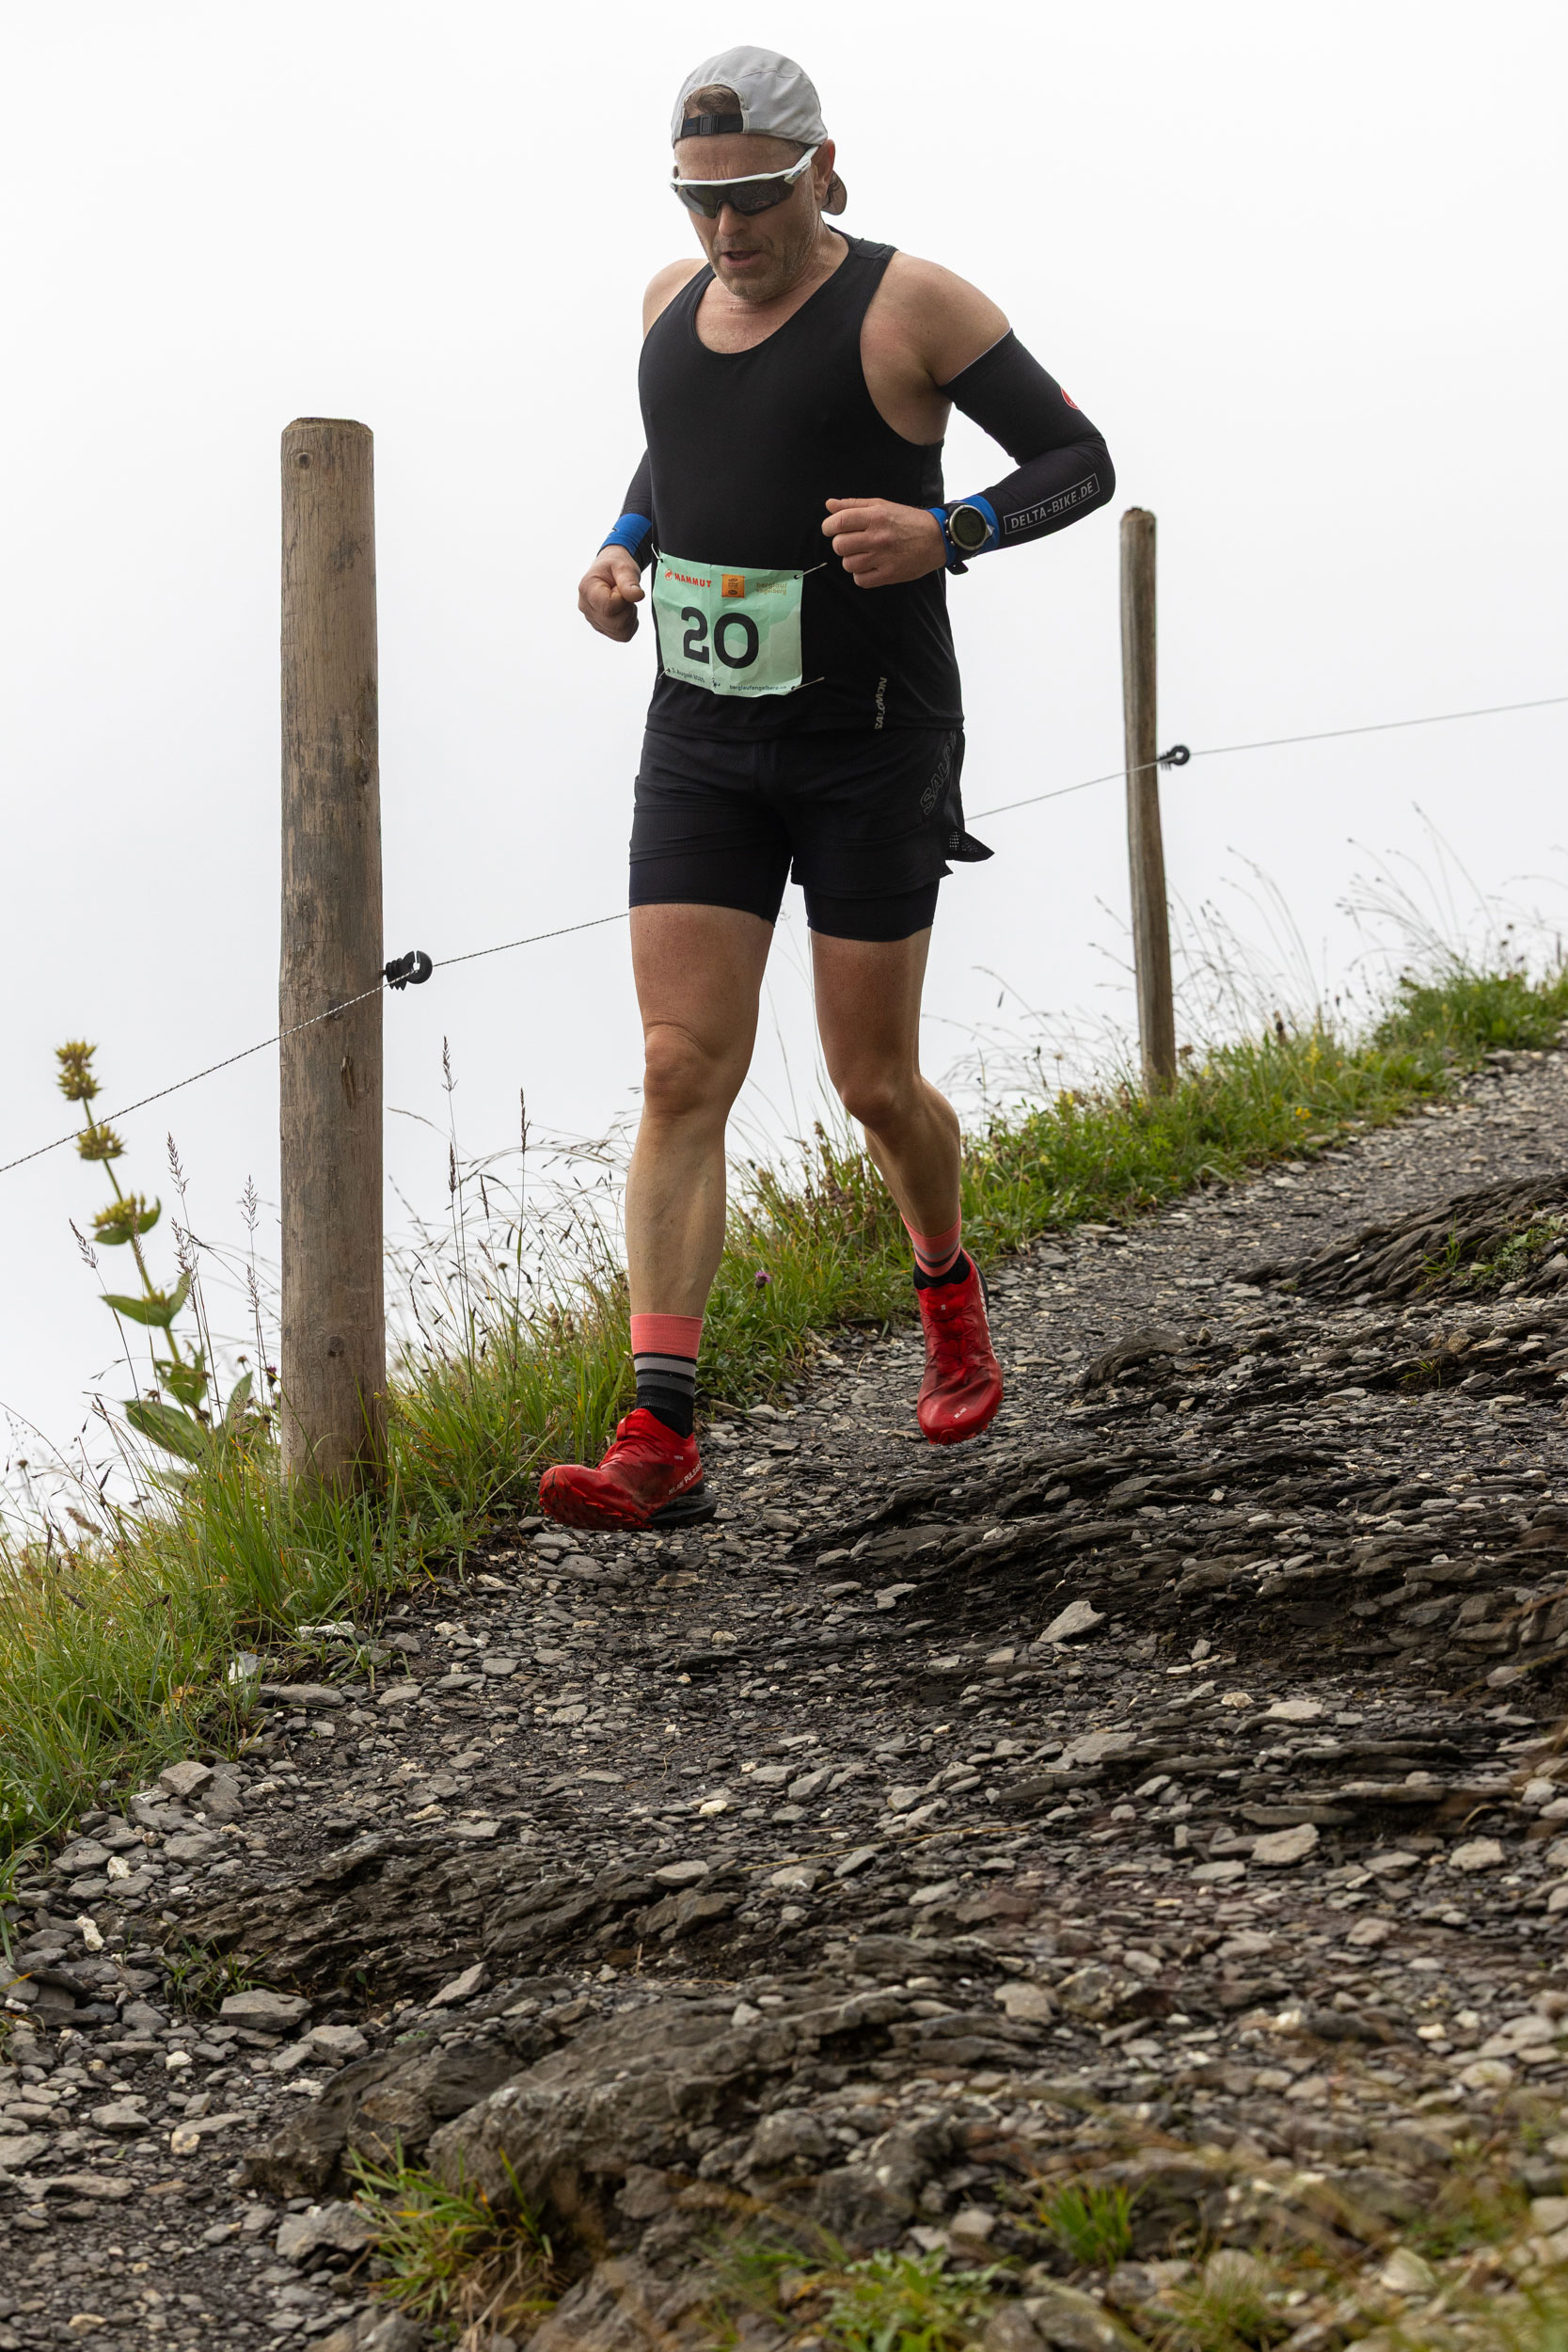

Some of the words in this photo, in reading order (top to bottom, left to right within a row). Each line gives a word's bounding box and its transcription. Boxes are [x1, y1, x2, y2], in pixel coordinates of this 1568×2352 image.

[1011, 481, 1094, 529] DELTA-BIKE.DE
[674, 572, 712, 588] MAMMUT
[681, 606, 759, 670] 20
[874, 676, 888, 730] SALOMON
